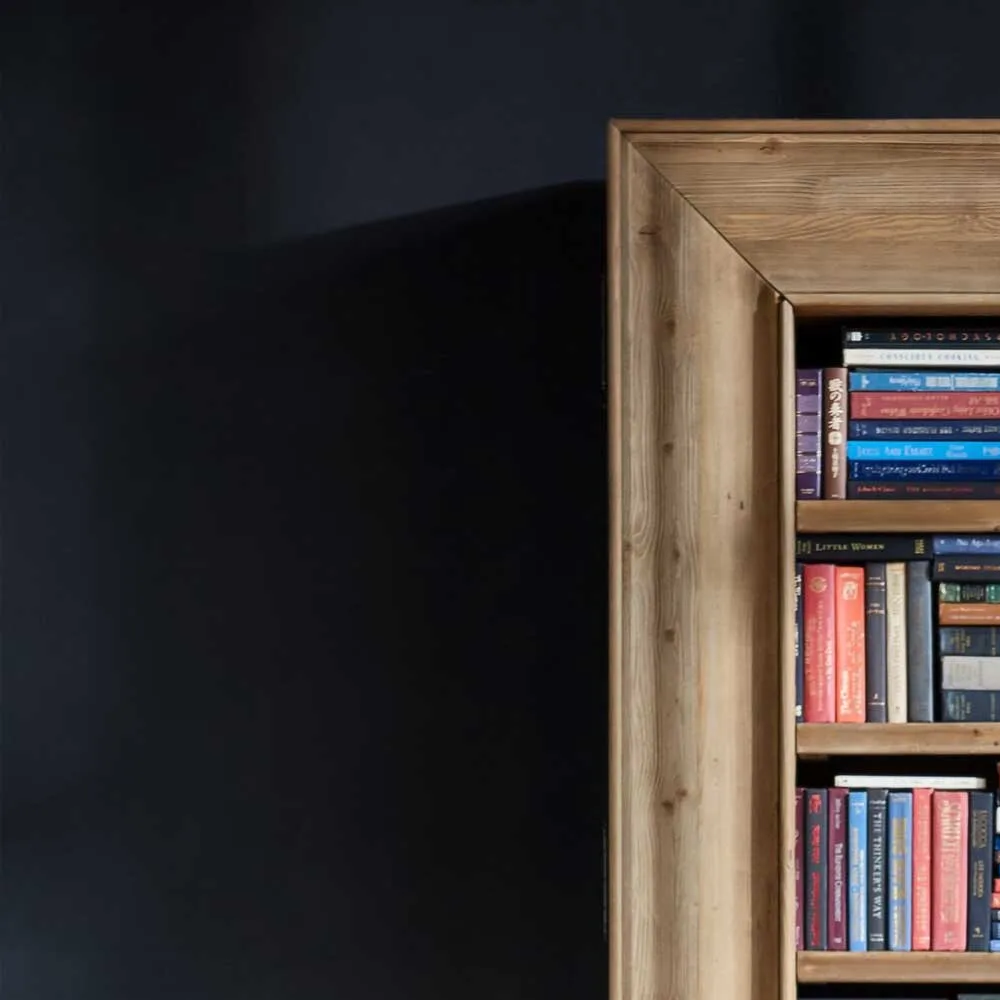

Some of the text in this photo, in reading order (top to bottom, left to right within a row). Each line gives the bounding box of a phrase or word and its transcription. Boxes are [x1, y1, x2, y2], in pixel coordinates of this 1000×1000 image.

[815, 543, 848, 551] LITTLE
[872, 812, 883, 920] THE THINKER'S WAY
